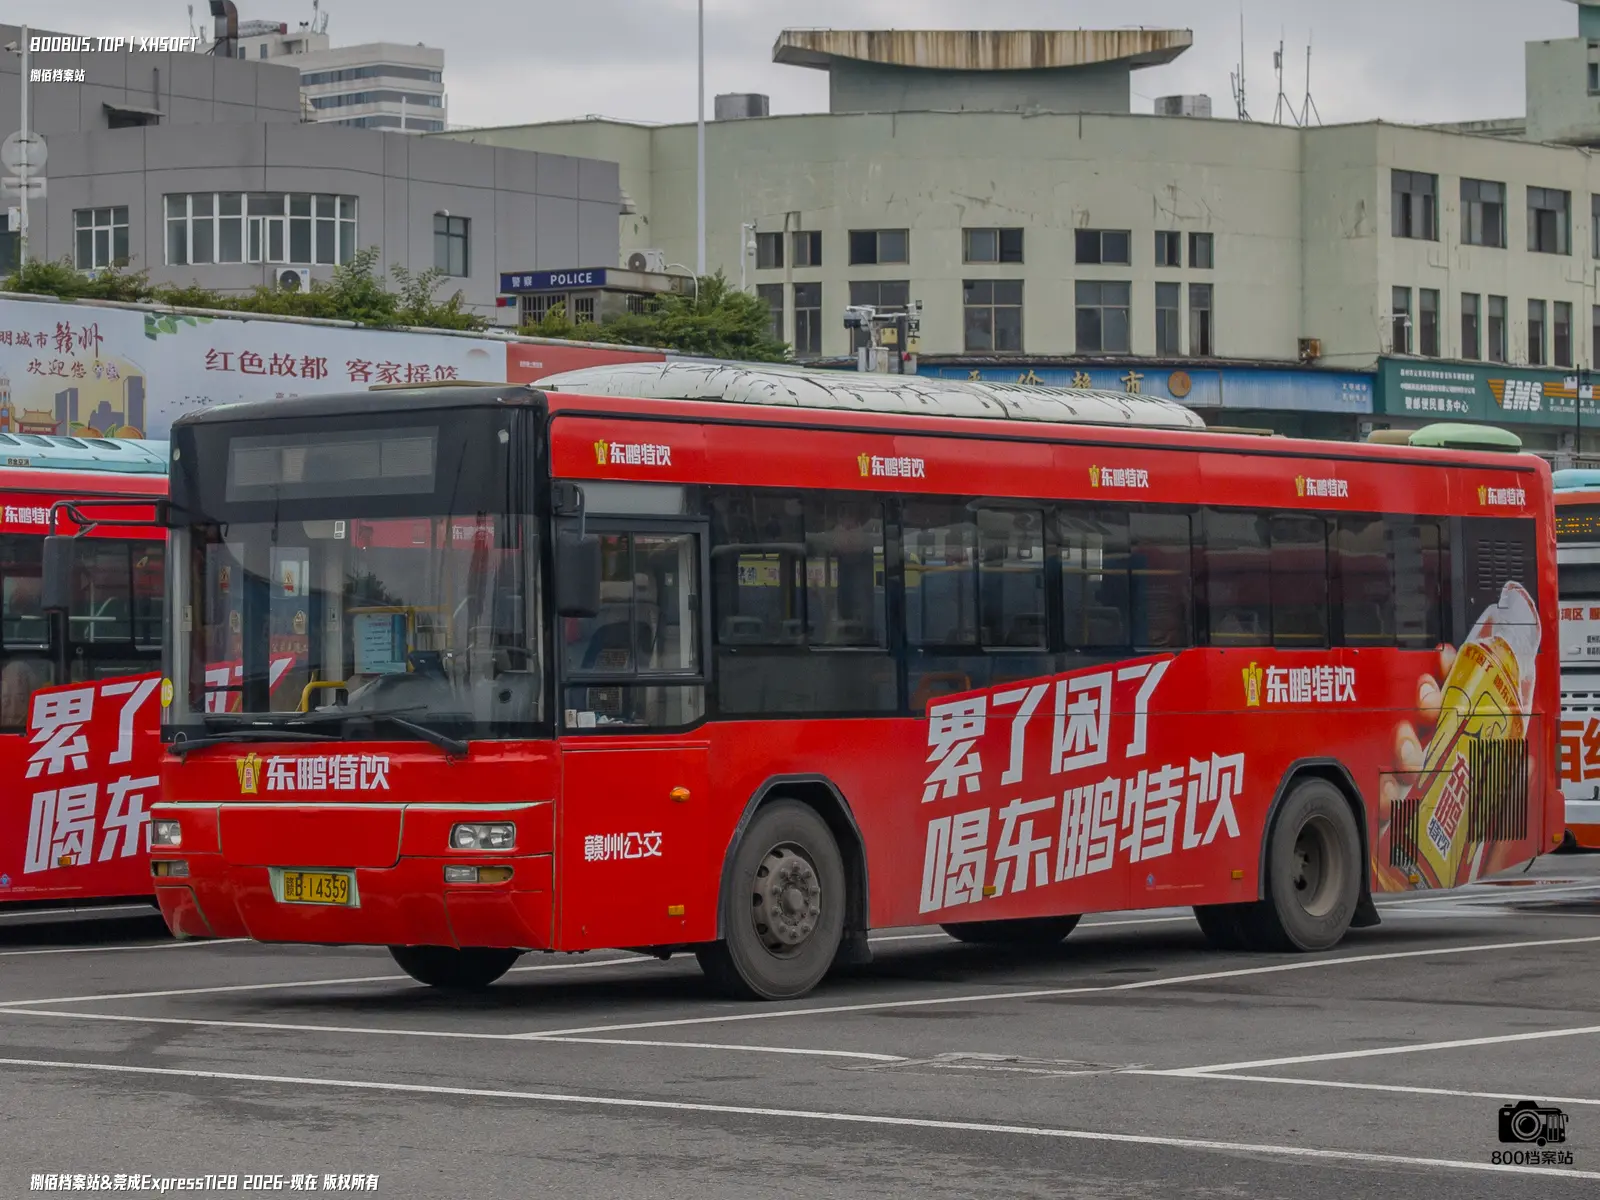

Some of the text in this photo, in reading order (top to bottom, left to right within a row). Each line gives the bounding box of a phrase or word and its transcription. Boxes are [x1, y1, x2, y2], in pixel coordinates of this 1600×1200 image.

[511, 272, 593, 288] 警察 POLICE
[26, 358, 87, 379] 欢迎您
[205, 348, 329, 380] 红色故都
[1502, 379, 1542, 411] EMS
[610, 442, 672, 466] 东鹏特饮
[871, 455, 925, 477] 东鹏特饮
[1101, 467, 1149, 488] 东鹏特饮
[1306, 477, 1348, 498] 东鹏特饮
[1488, 487, 1526, 506] 东鹏特饮
[1266, 665, 1357, 702] 东鹏特饮
[25, 677, 162, 779] 累了
[921, 660, 1171, 803] 累了困了
[267, 755, 390, 790] 东鹏特饮
[23, 774, 160, 874] 喝东
[918, 752, 1245, 914] 喝东鹏特饮
[584, 830, 662, 862] 赣州公交
